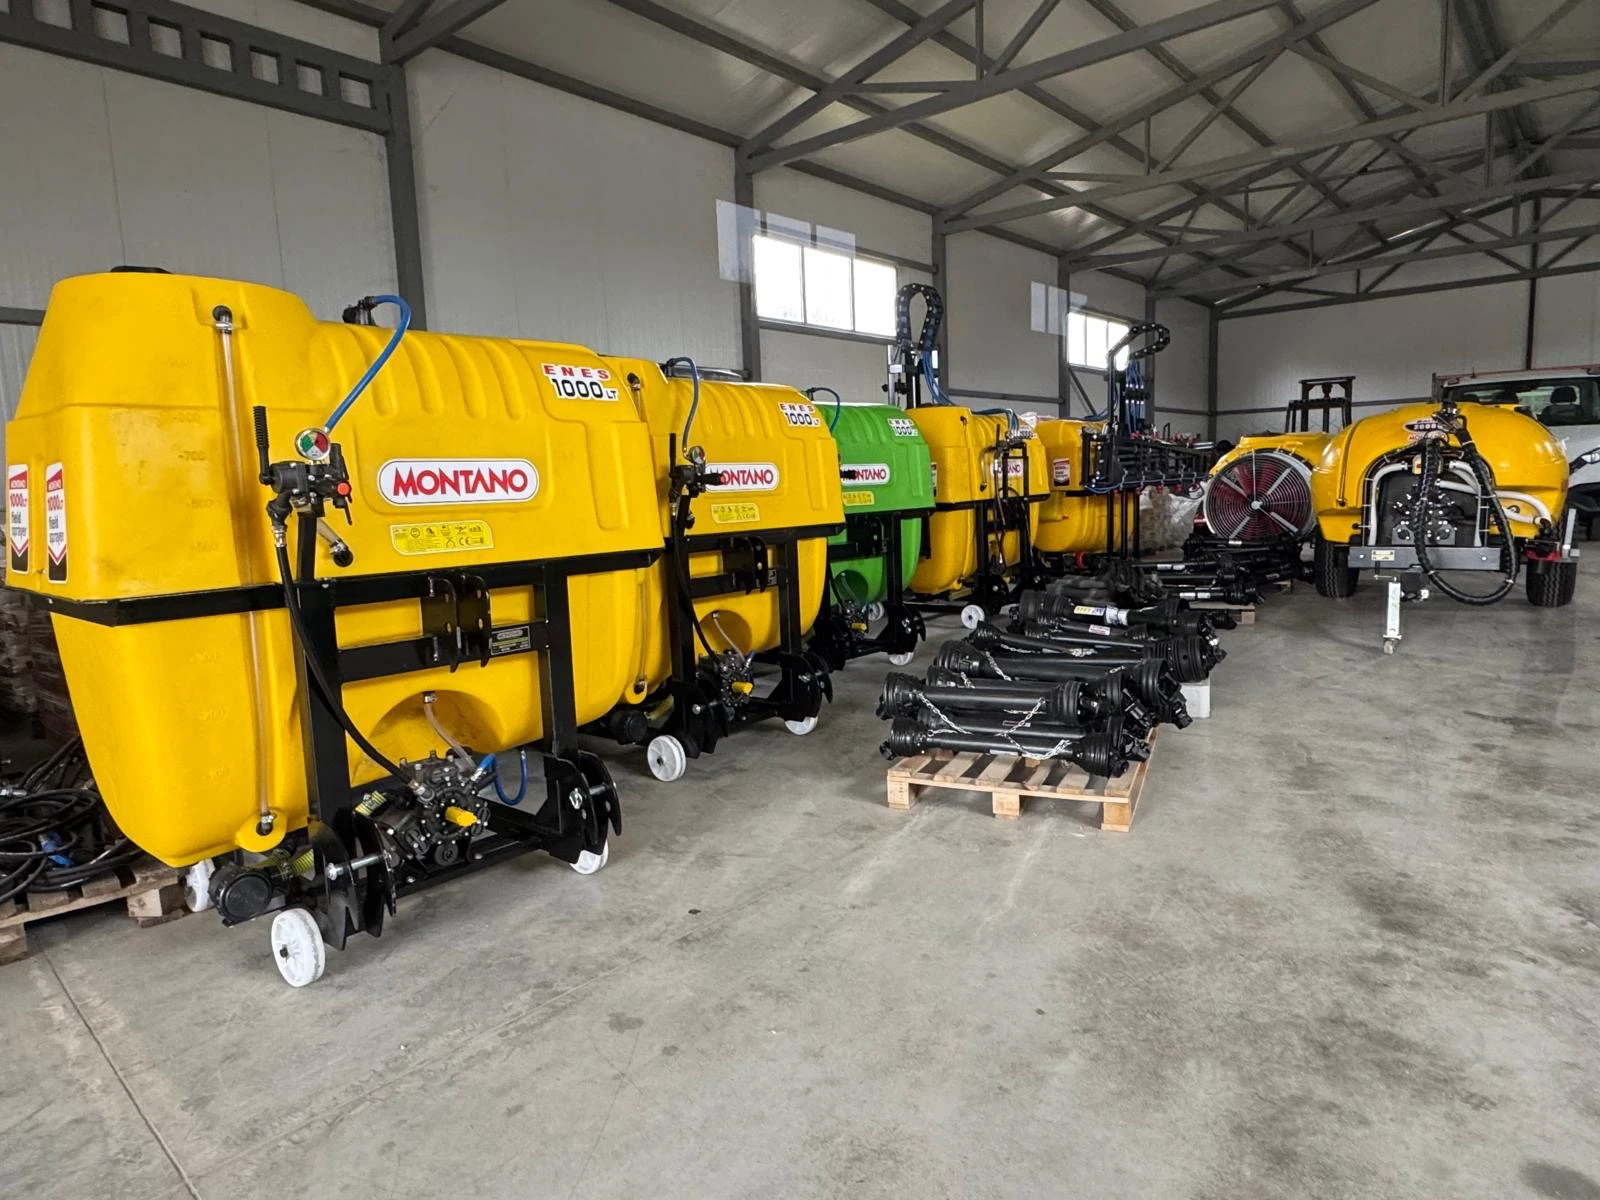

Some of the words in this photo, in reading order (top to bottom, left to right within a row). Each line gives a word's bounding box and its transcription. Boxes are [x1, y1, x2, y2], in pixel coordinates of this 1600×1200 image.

[543, 365, 609, 379] ENES
[552, 379, 603, 398] 1000
[780, 403, 814, 412] ENES
[785, 413, 812, 425] 1000
[393, 467, 528, 497] MONTANO
[710, 467, 773, 486] ONTANO
